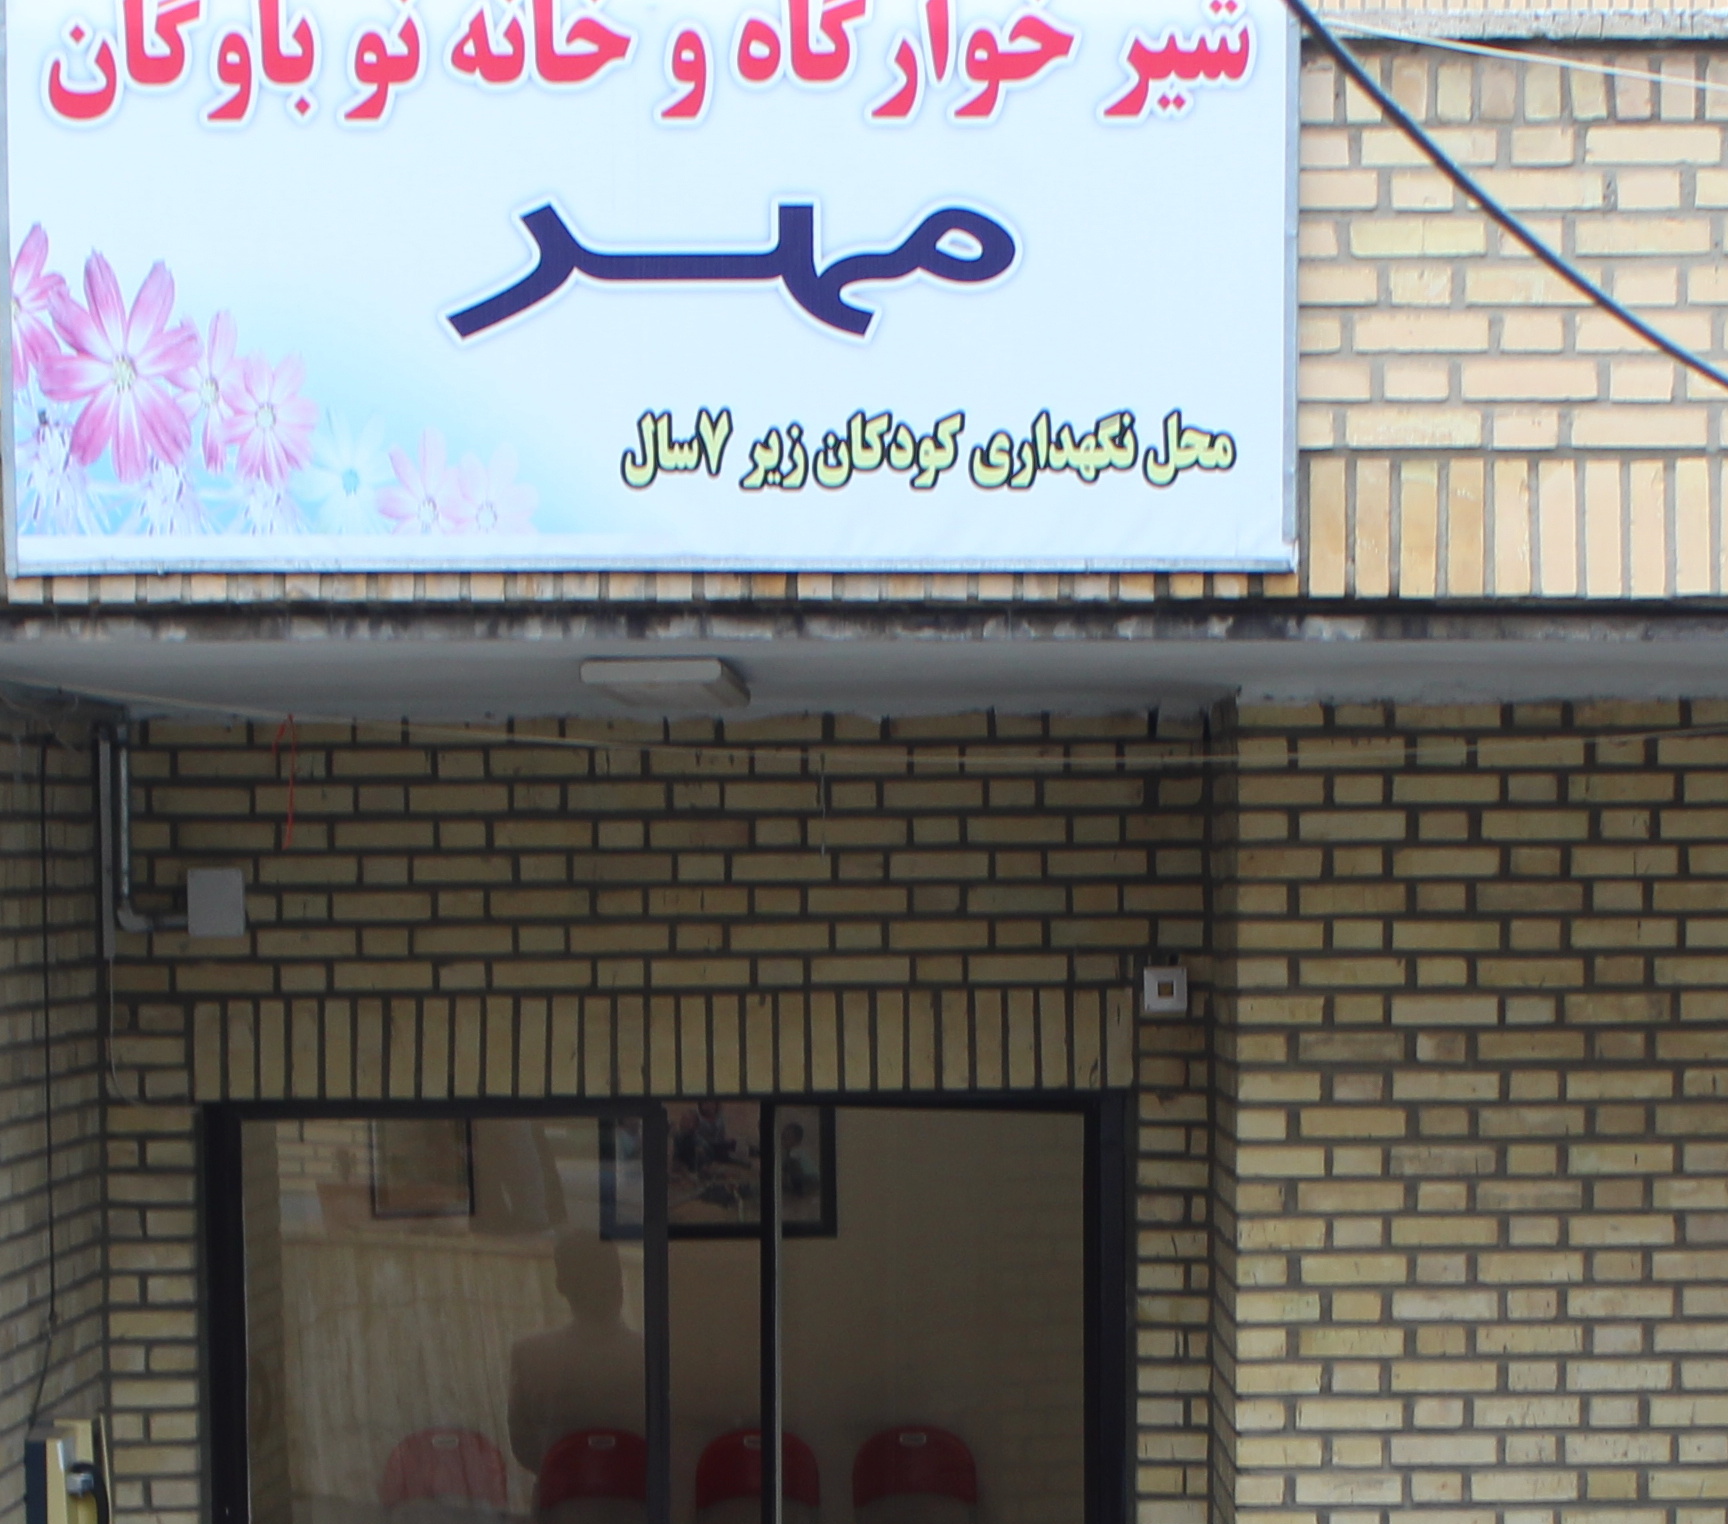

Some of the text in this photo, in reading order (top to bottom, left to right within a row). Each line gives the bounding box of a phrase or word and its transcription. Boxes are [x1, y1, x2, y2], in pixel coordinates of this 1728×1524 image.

[660, 30, 707, 118] و
[1102, 0, 1251, 118] شیر
[449, 204, 1016, 338] مهر
[739, 424, 810, 490] زیر
[812, 412, 966, 490] کودکان
[969, 411, 1140, 490] نگهداری
[1142, 411, 1238, 489] محل
